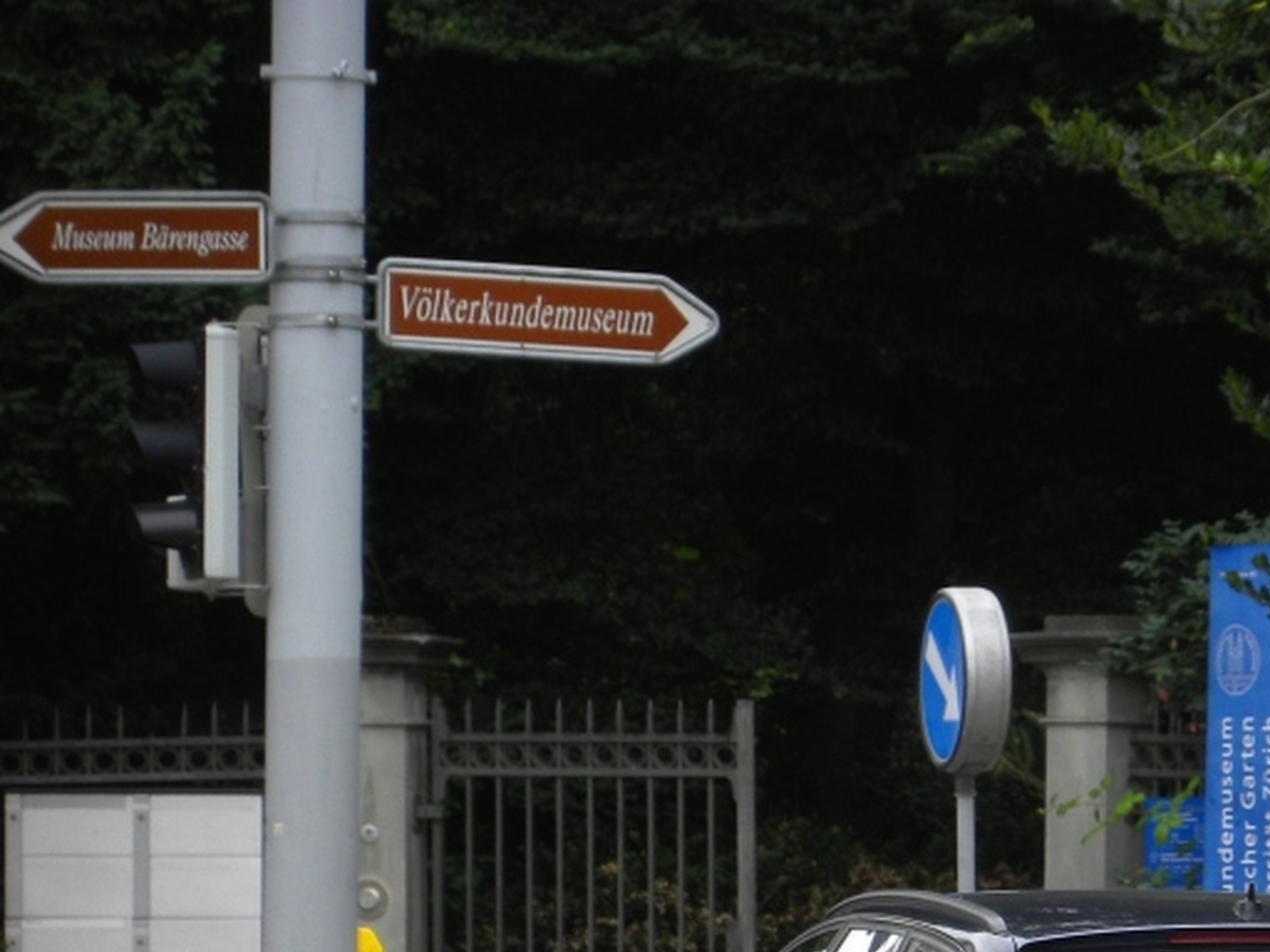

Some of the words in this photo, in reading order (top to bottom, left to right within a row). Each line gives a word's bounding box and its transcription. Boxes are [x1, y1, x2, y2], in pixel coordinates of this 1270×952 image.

[52, 221, 136, 251] Museum
[140, 221, 250, 257] Bärengasse
[400, 284, 655, 337] Völkerkundemuseum
[1240, 716, 1257, 809] Garten
